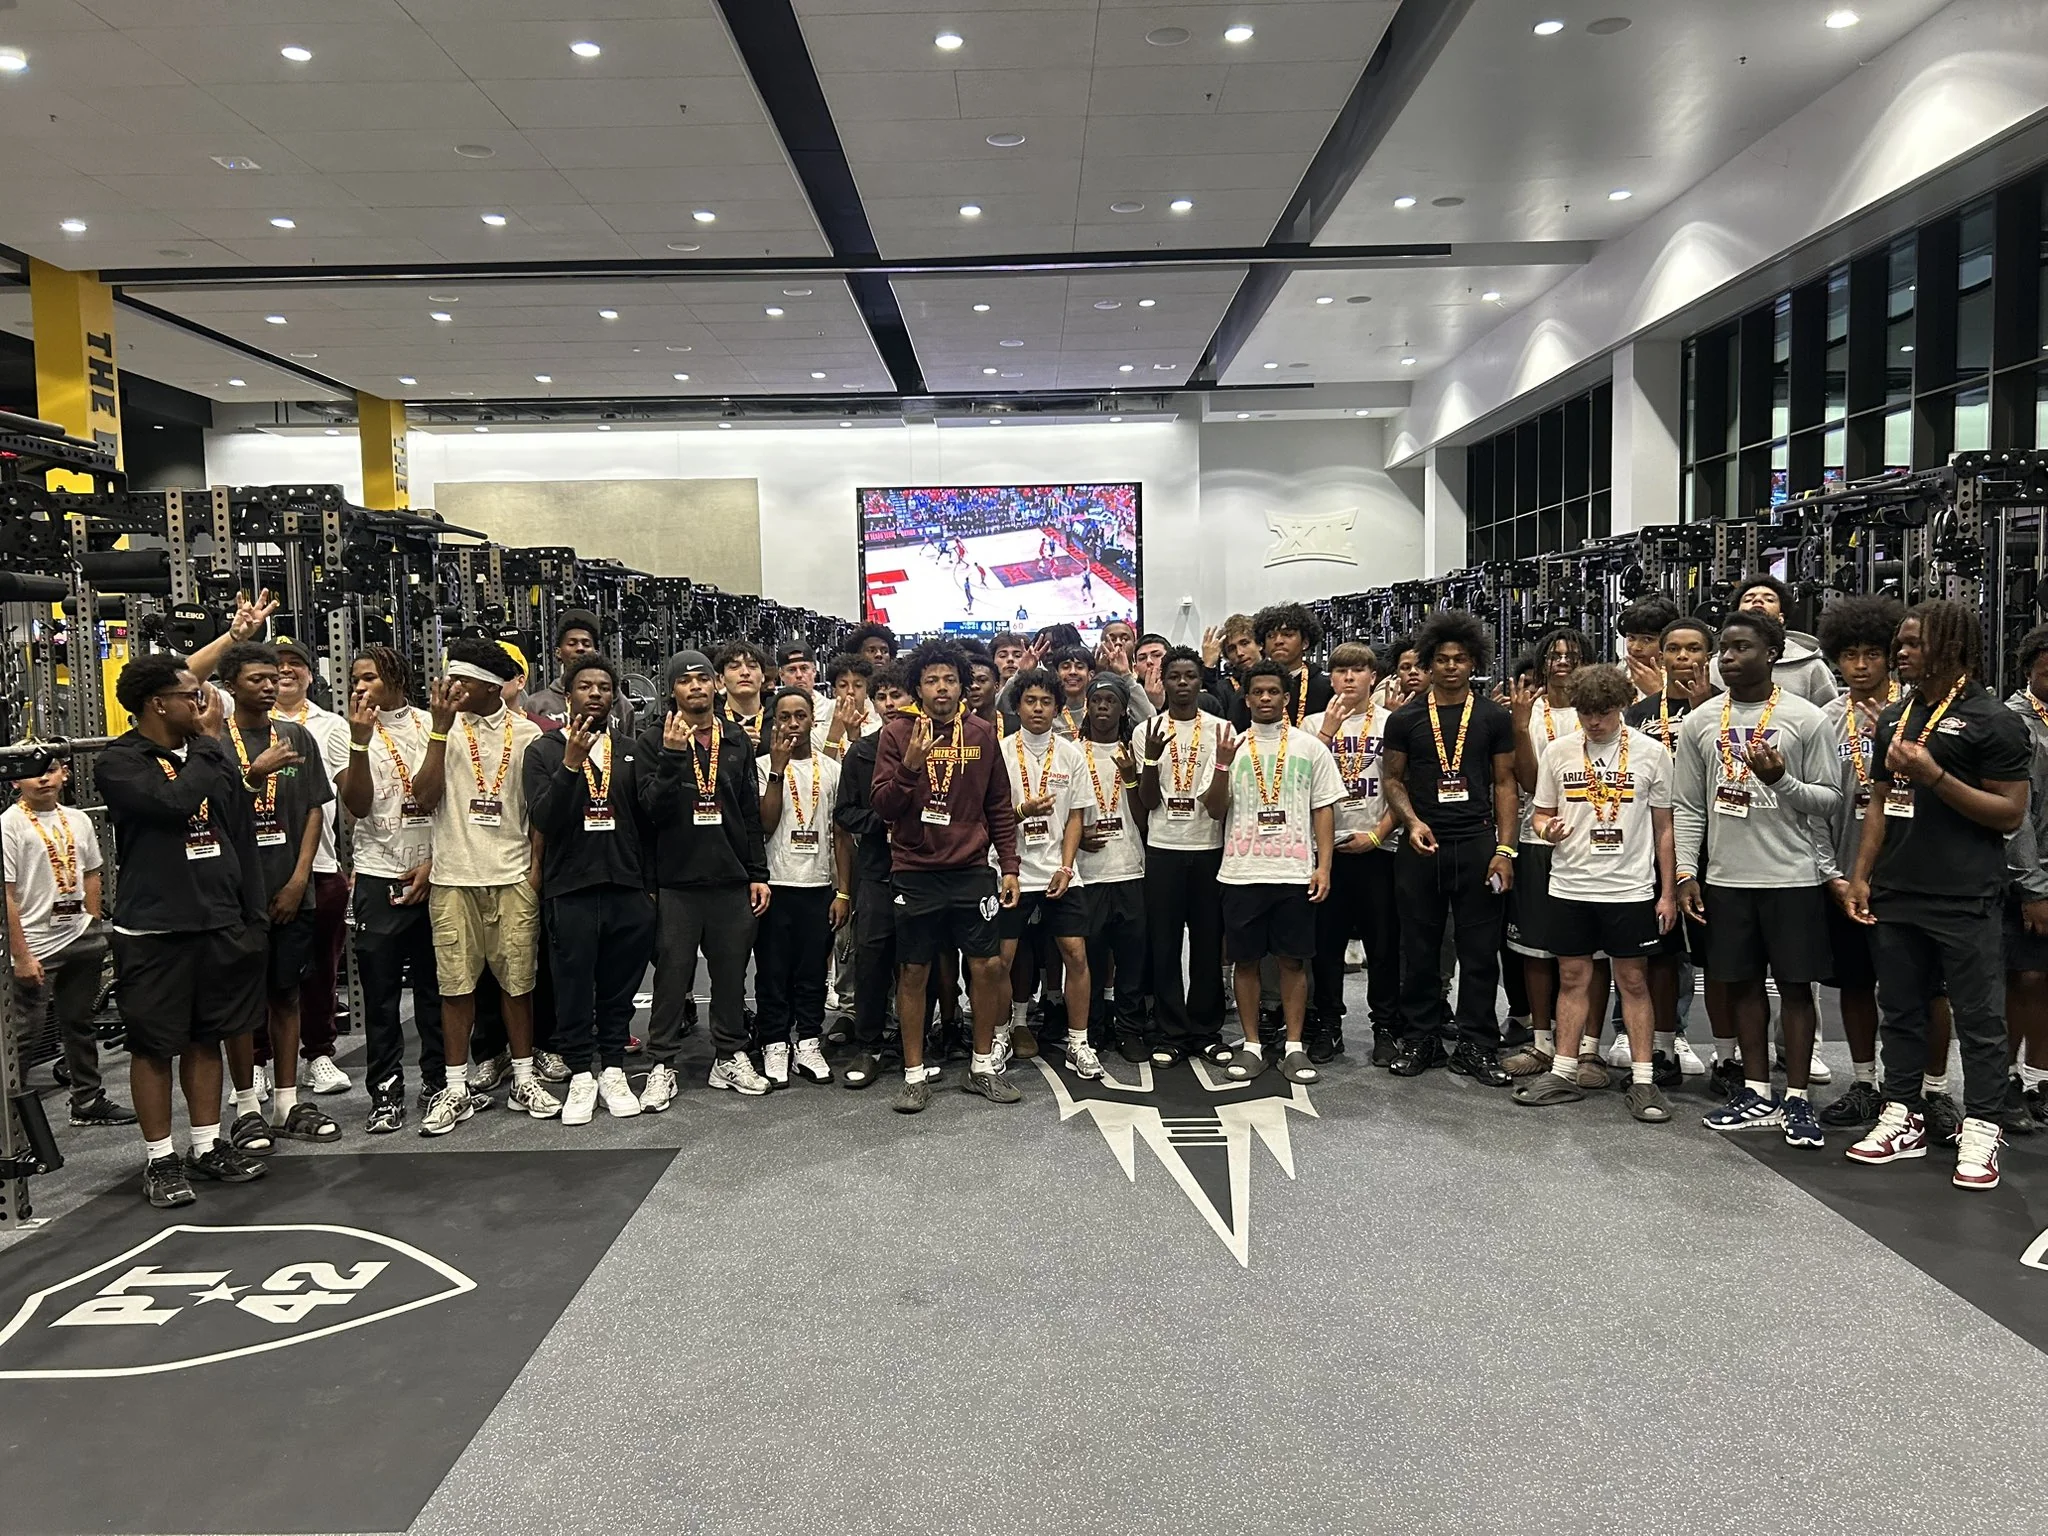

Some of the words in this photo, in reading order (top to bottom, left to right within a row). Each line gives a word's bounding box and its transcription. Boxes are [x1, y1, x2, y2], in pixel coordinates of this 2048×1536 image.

[87, 332, 116, 418] THE
[393, 436, 408, 494] THE
[175, 611, 205, 620] ELEIKO
[980, 621, 993, 632] 63
[469, 742, 481, 763] ASU
[501, 746, 512, 765] ASU
[1252, 757, 1264, 776] ASU
[1274, 758, 1285, 776] ASU
[1038, 770, 1049, 791] ASU
[1089, 770, 1100, 788] ASU
[1562, 771, 1603, 783] ARIZOA
[1605, 771, 1635, 782] STTE
[47, 1265, 233, 1328] PT
[235, 1261, 391, 1324] 42
